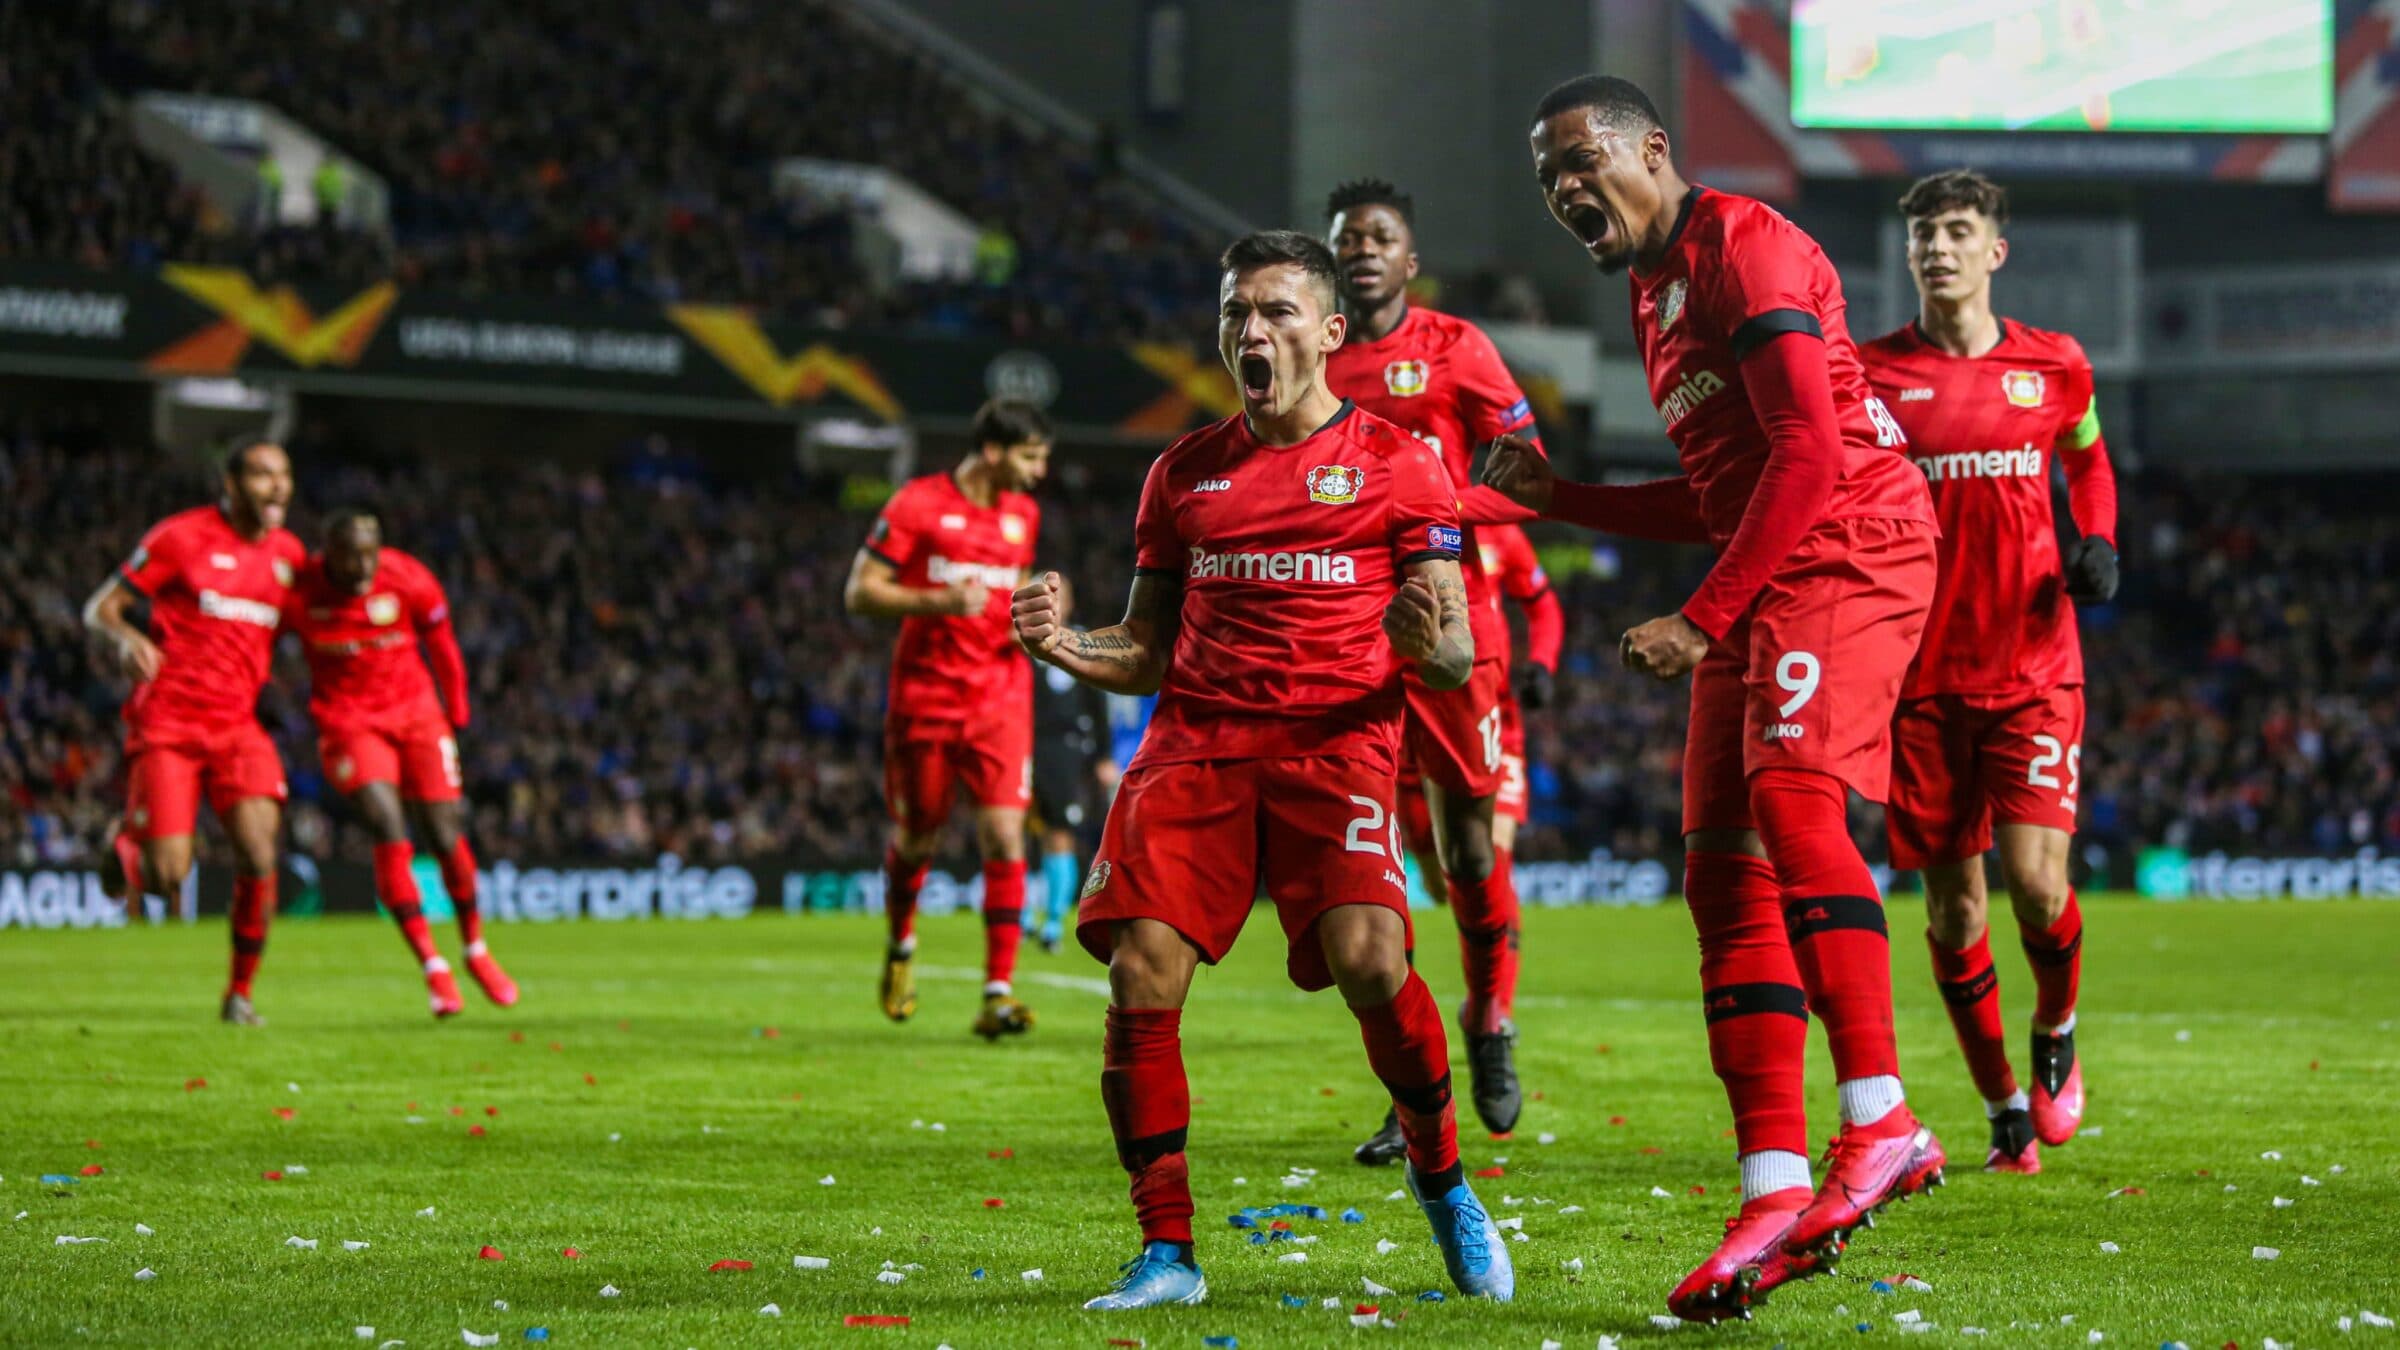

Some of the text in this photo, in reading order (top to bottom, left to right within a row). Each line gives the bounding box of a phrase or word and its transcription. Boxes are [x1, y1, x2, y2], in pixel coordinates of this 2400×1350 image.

[1909, 442, 2042, 481] armenia
[1192, 479, 1232, 493] JAKO
[1189, 546, 1357, 584] Barmenia
[1775, 650, 1820, 720] 9
[1763, 722, 1804, 742] JAKO
